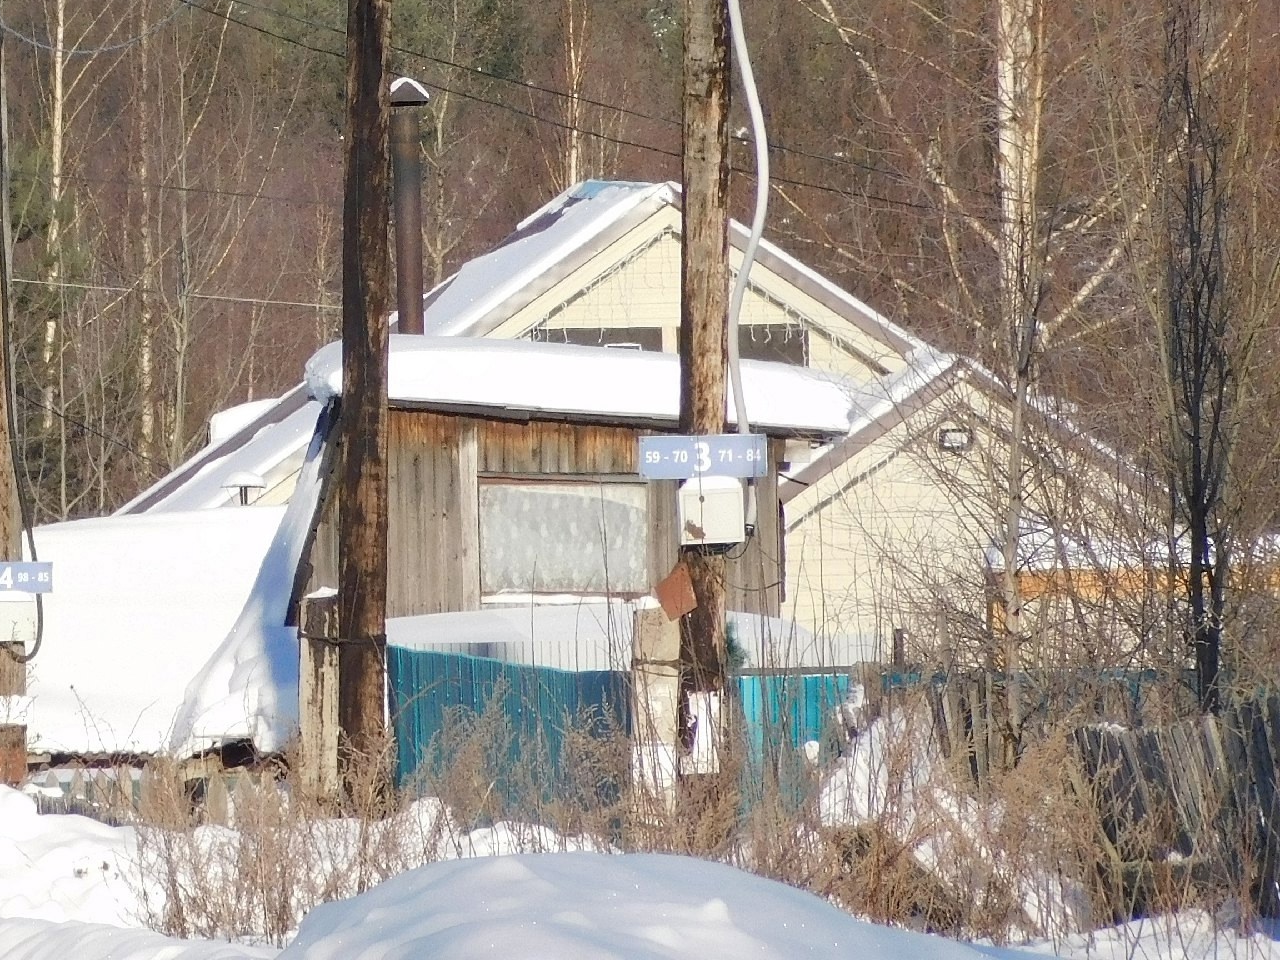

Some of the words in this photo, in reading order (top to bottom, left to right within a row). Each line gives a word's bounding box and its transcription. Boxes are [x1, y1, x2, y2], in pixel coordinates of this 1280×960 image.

[645, 451, 660, 463] 59
[672, 450, 688, 463] 70
[693, 442, 712, 472] 3
[718, 450, 733, 462] 71
[746, 449, 761, 462] 84
[17, 572, 29, 583] 98
[37, 572, 49, 582] 85
